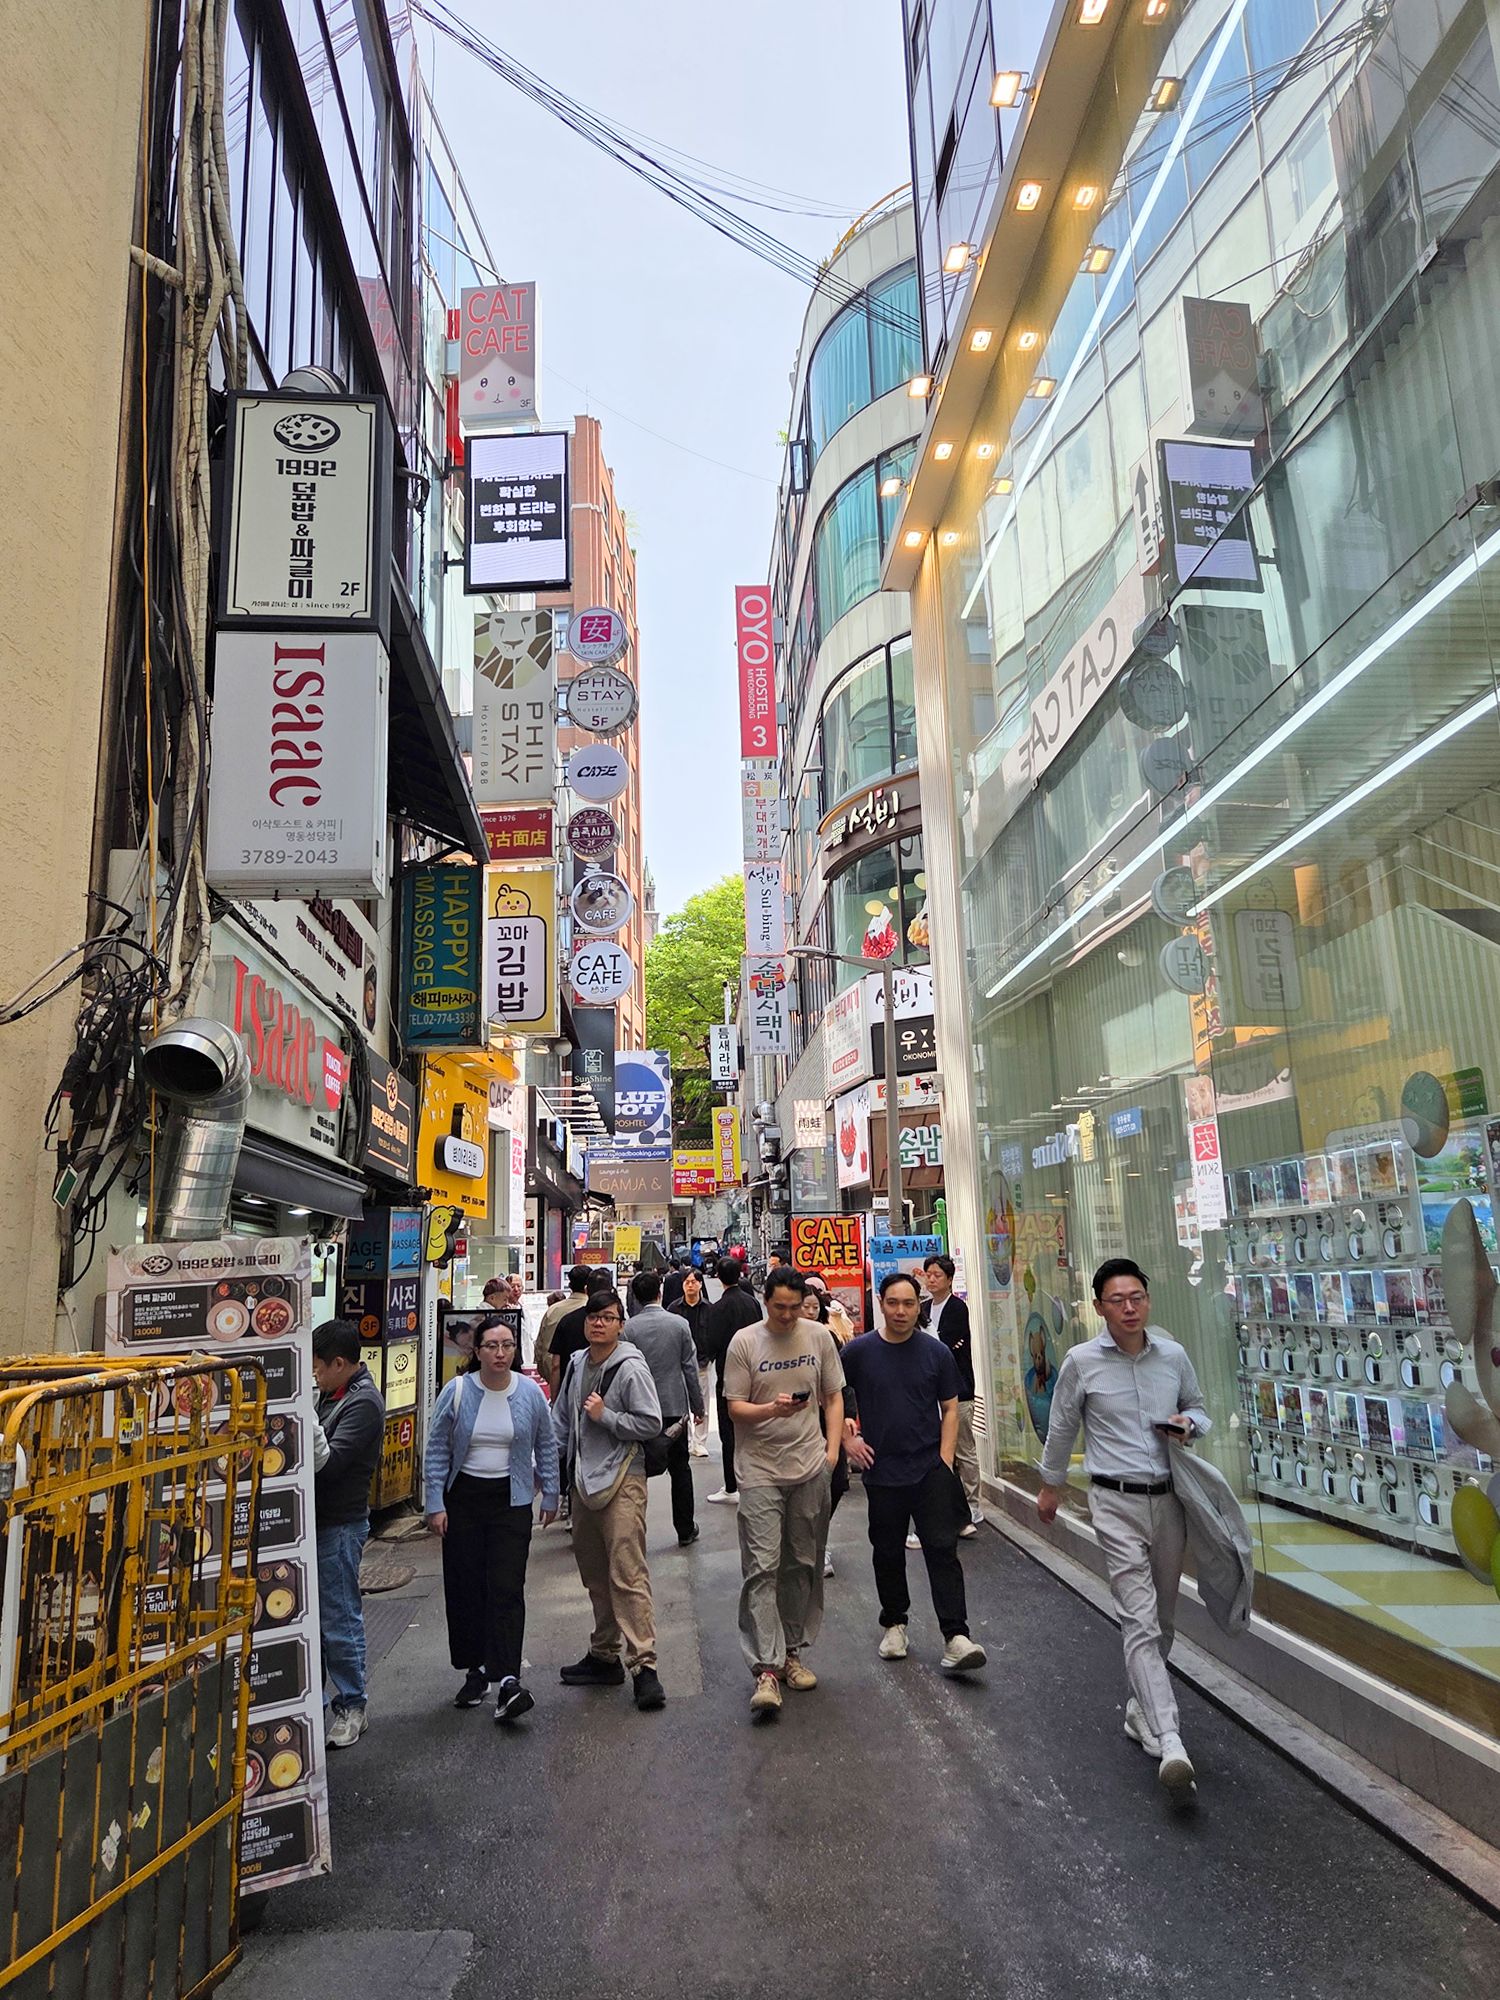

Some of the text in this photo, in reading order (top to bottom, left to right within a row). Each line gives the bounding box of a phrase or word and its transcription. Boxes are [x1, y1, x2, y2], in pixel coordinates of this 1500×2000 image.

[467, 288, 528, 325] CAT
[465, 325, 529, 357] CAFE
[520, 399, 531, 408] 3F
[276, 459, 336, 477] 1992
[499, 484, 536, 499] 확실한
[518, 501, 557, 516] 드리는
[340, 582, 360, 596] 2F
[331, 602, 351, 610] 1992
[583, 617, 609, 642] 安
[741, 594, 769, 665] OYO
[577, 691, 625, 701] STAY
[756, 667, 769, 719] HOSTEL
[269, 641, 325, 807] Isaac
[480, 705, 489, 747] Hostel
[591, 715, 609, 727] 5F
[501, 703, 520, 784] STAY
[526, 702, 544, 783] PHIL
[752, 725, 767, 747] 3
[480, 761, 489, 785] B&B
[252, 819, 336, 830] 이삭토스트 & 커피
[481, 814, 516, 823] ince 1976
[538, 813, 547, 821] 2F
[755, 798, 768, 849] 부대찌개
[286, 831, 336, 842] 명동성당점
[241, 850, 339, 864] 3789-2043
[757, 851, 768, 859] 3F
[749, 867, 780, 886] 설빙
[588, 881, 612, 890] CAT
[585, 910, 616, 920] CAFE
[413, 876, 435, 986] MASSAGE
[442, 875, 470, 977] HAPPY
[497, 926, 529, 940] 꼬마
[578, 955, 621, 971] CAT
[497, 946, 529, 1012] 김밥
[577, 971, 622, 985] CAFE
[413, 991, 473, 1007] 해피마사지
[753, 961, 782, 1043] 순남시래기
[233, 955, 317, 1106] Isaac
[461, 1027, 473, 1039] 4F
[900, 1031, 917, 1050] 우
[719, 1027, 730, 1077] 틈새라면
[574, 1075, 612, 1083] SunShine
[490, 1081, 512, 1115] CAFE
[615, 1091, 664, 1103] LUE
[600, 1177, 662, 1191] GAMJA &
[797, 1218, 855, 1245] CAT
[350, 1241, 382, 1256] AGE
[392, 1239, 421, 1249] MASSAGE
[796, 1244, 859, 1267] CAFE
[178, 1258, 209, 1270] 1992
[365, 1261, 375, 1269] 4F
[345, 1284, 365, 1314] 진
[391, 1283, 416, 1311] 사진
[363, 1322, 377, 1332] 3F
[367, 1351, 378, 1360] 2F
[759, 1355, 816, 1372] CrossFit
[401, 1423, 410, 1443] 占
